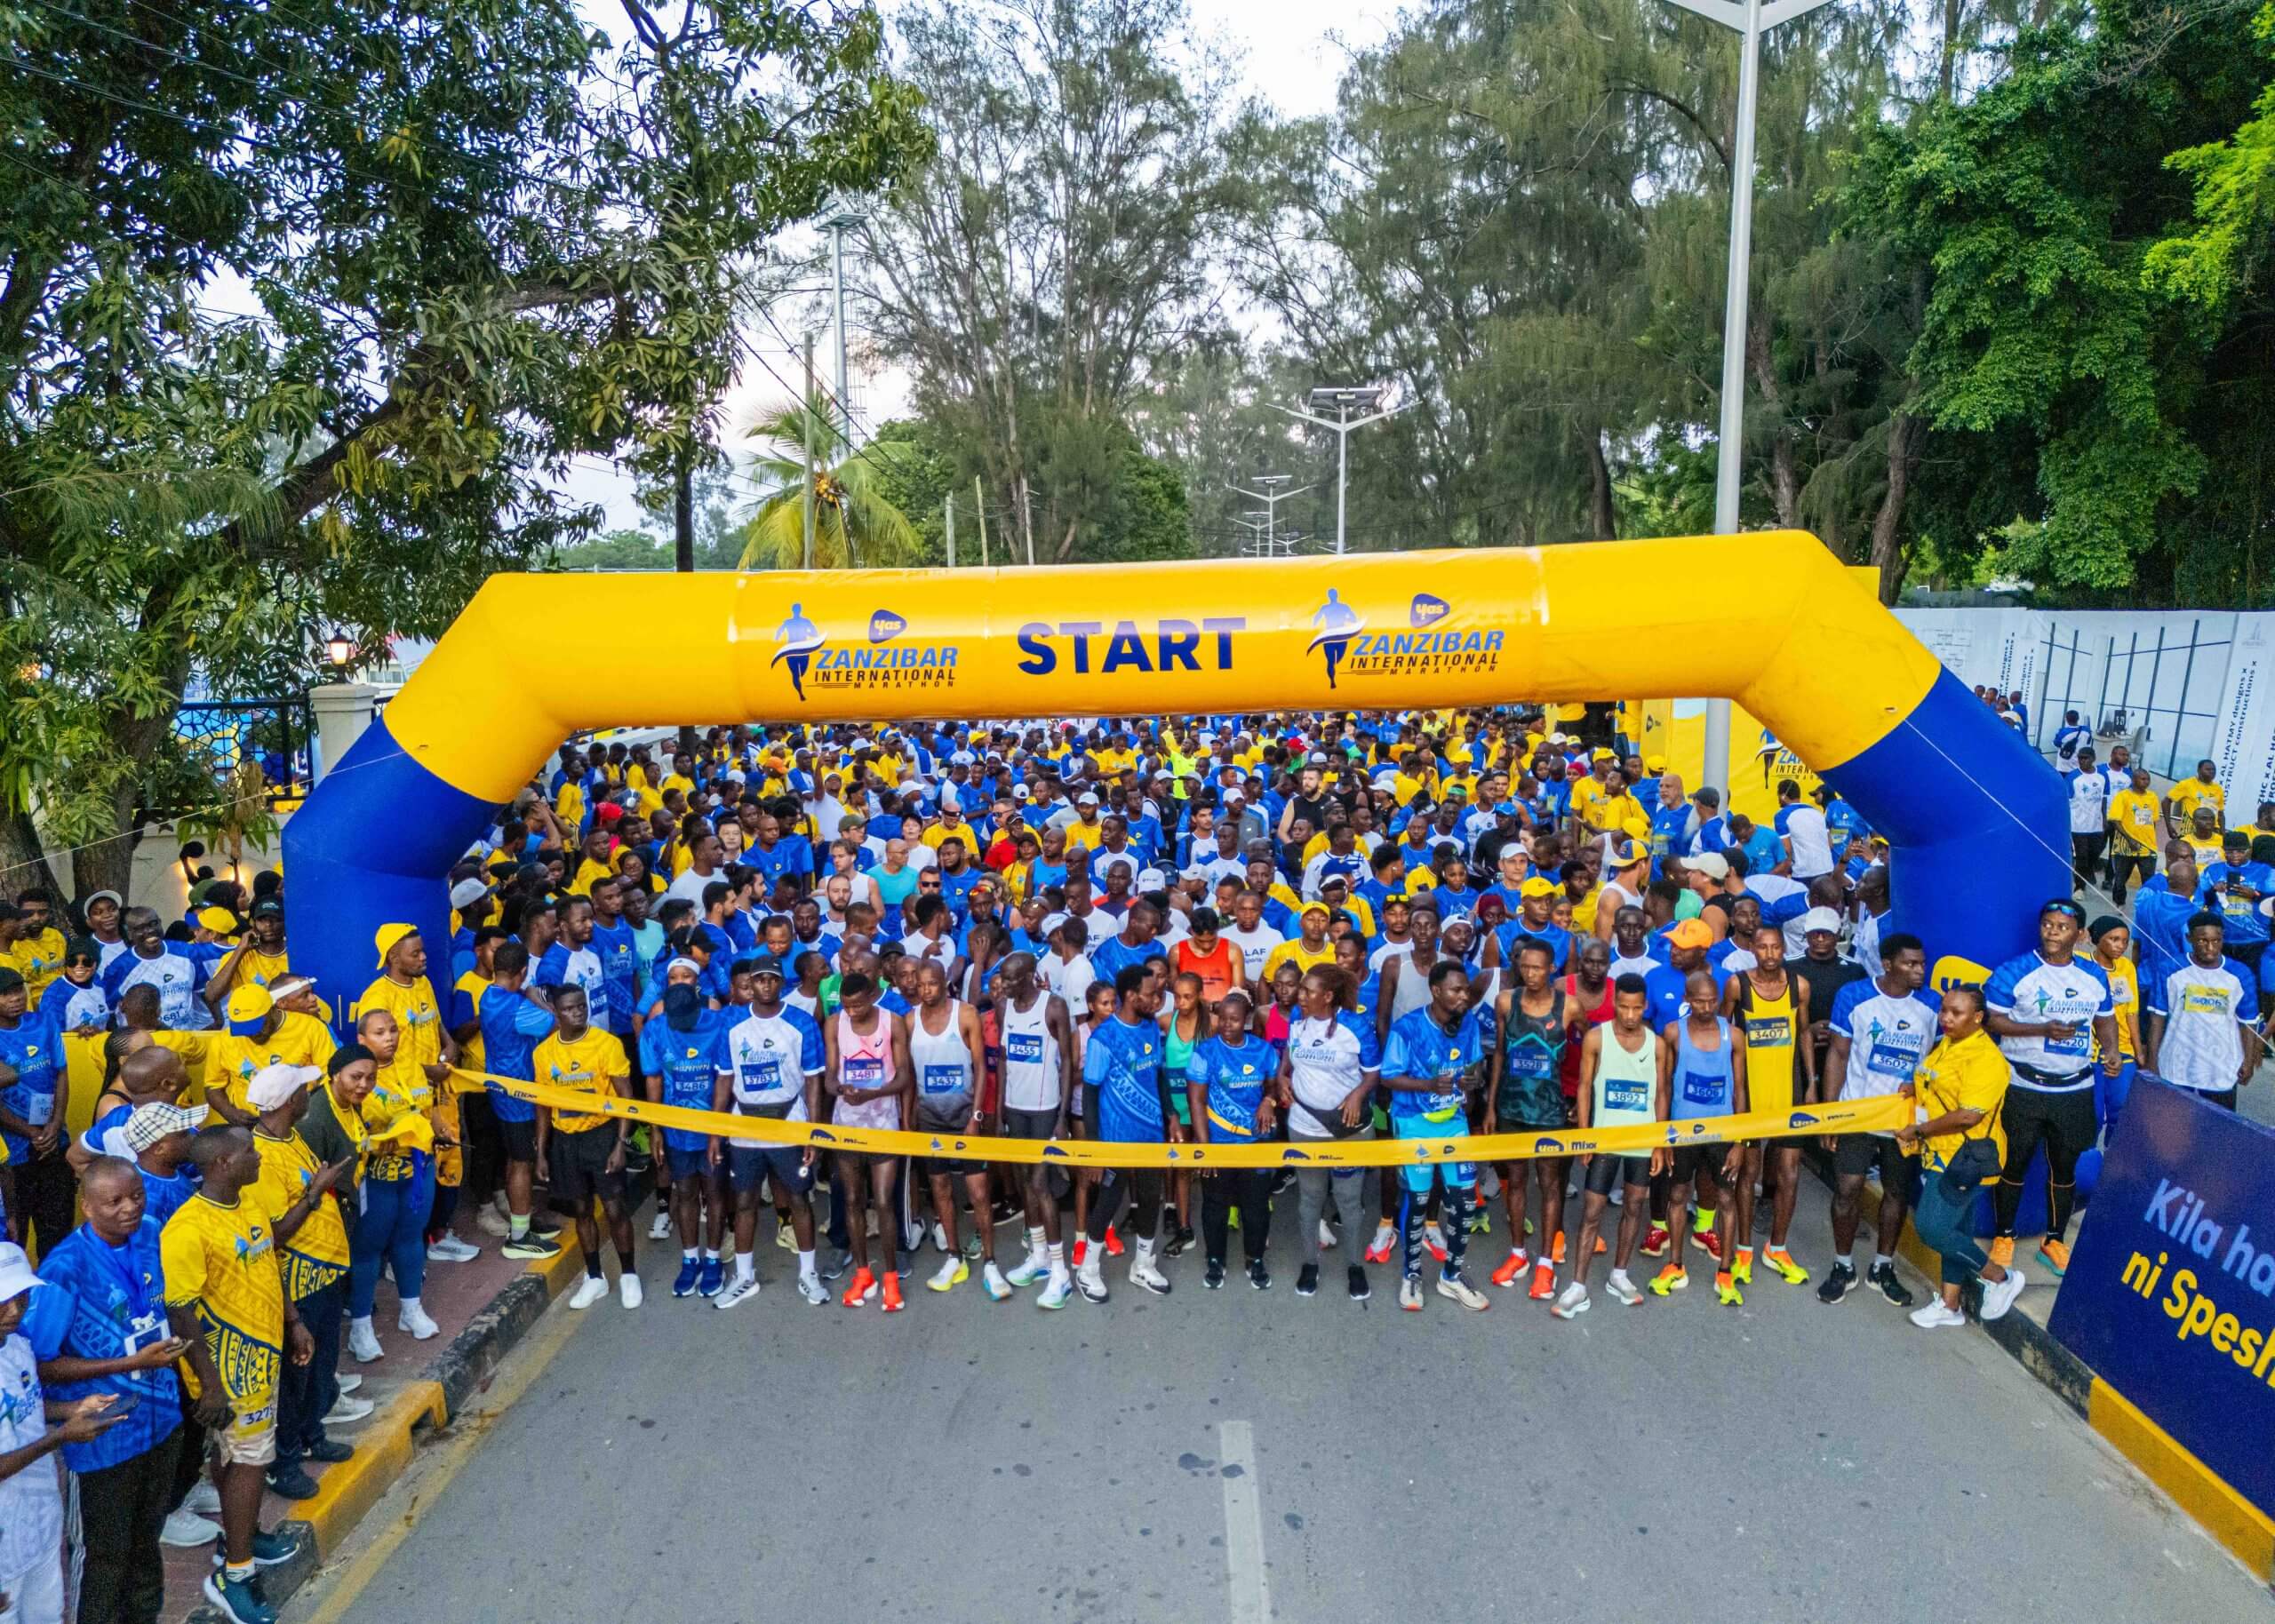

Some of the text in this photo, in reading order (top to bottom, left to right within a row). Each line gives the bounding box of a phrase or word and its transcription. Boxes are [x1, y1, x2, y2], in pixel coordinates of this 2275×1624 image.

[1416, 603, 1444, 619] yas
[874, 618, 902, 634] yas
[1018, 616, 1247, 675] START
[1353, 629, 1505, 656] ZANZIBAR
[815, 646, 959, 670] ZANZIBAR
[1350, 652, 1499, 670] INTERNATIONAL
[814, 668, 956, 684] INTERNATIONAL
[1389, 664, 1497, 676] MARATHON
[853, 681, 955, 689] MARATHON
[2235, 669, 2255, 746] constructions
[2223, 720, 2237, 760] HATMY
[2231, 676, 2246, 719] designs
[1755, 1029, 1784, 1039] 3407
[1877, 1054, 1908, 1070] 3602
[1613, 1092, 1640, 1102] 3892
[2144, 1177, 2223, 1260] Kila
[2120, 1251, 2168, 1300] ni
